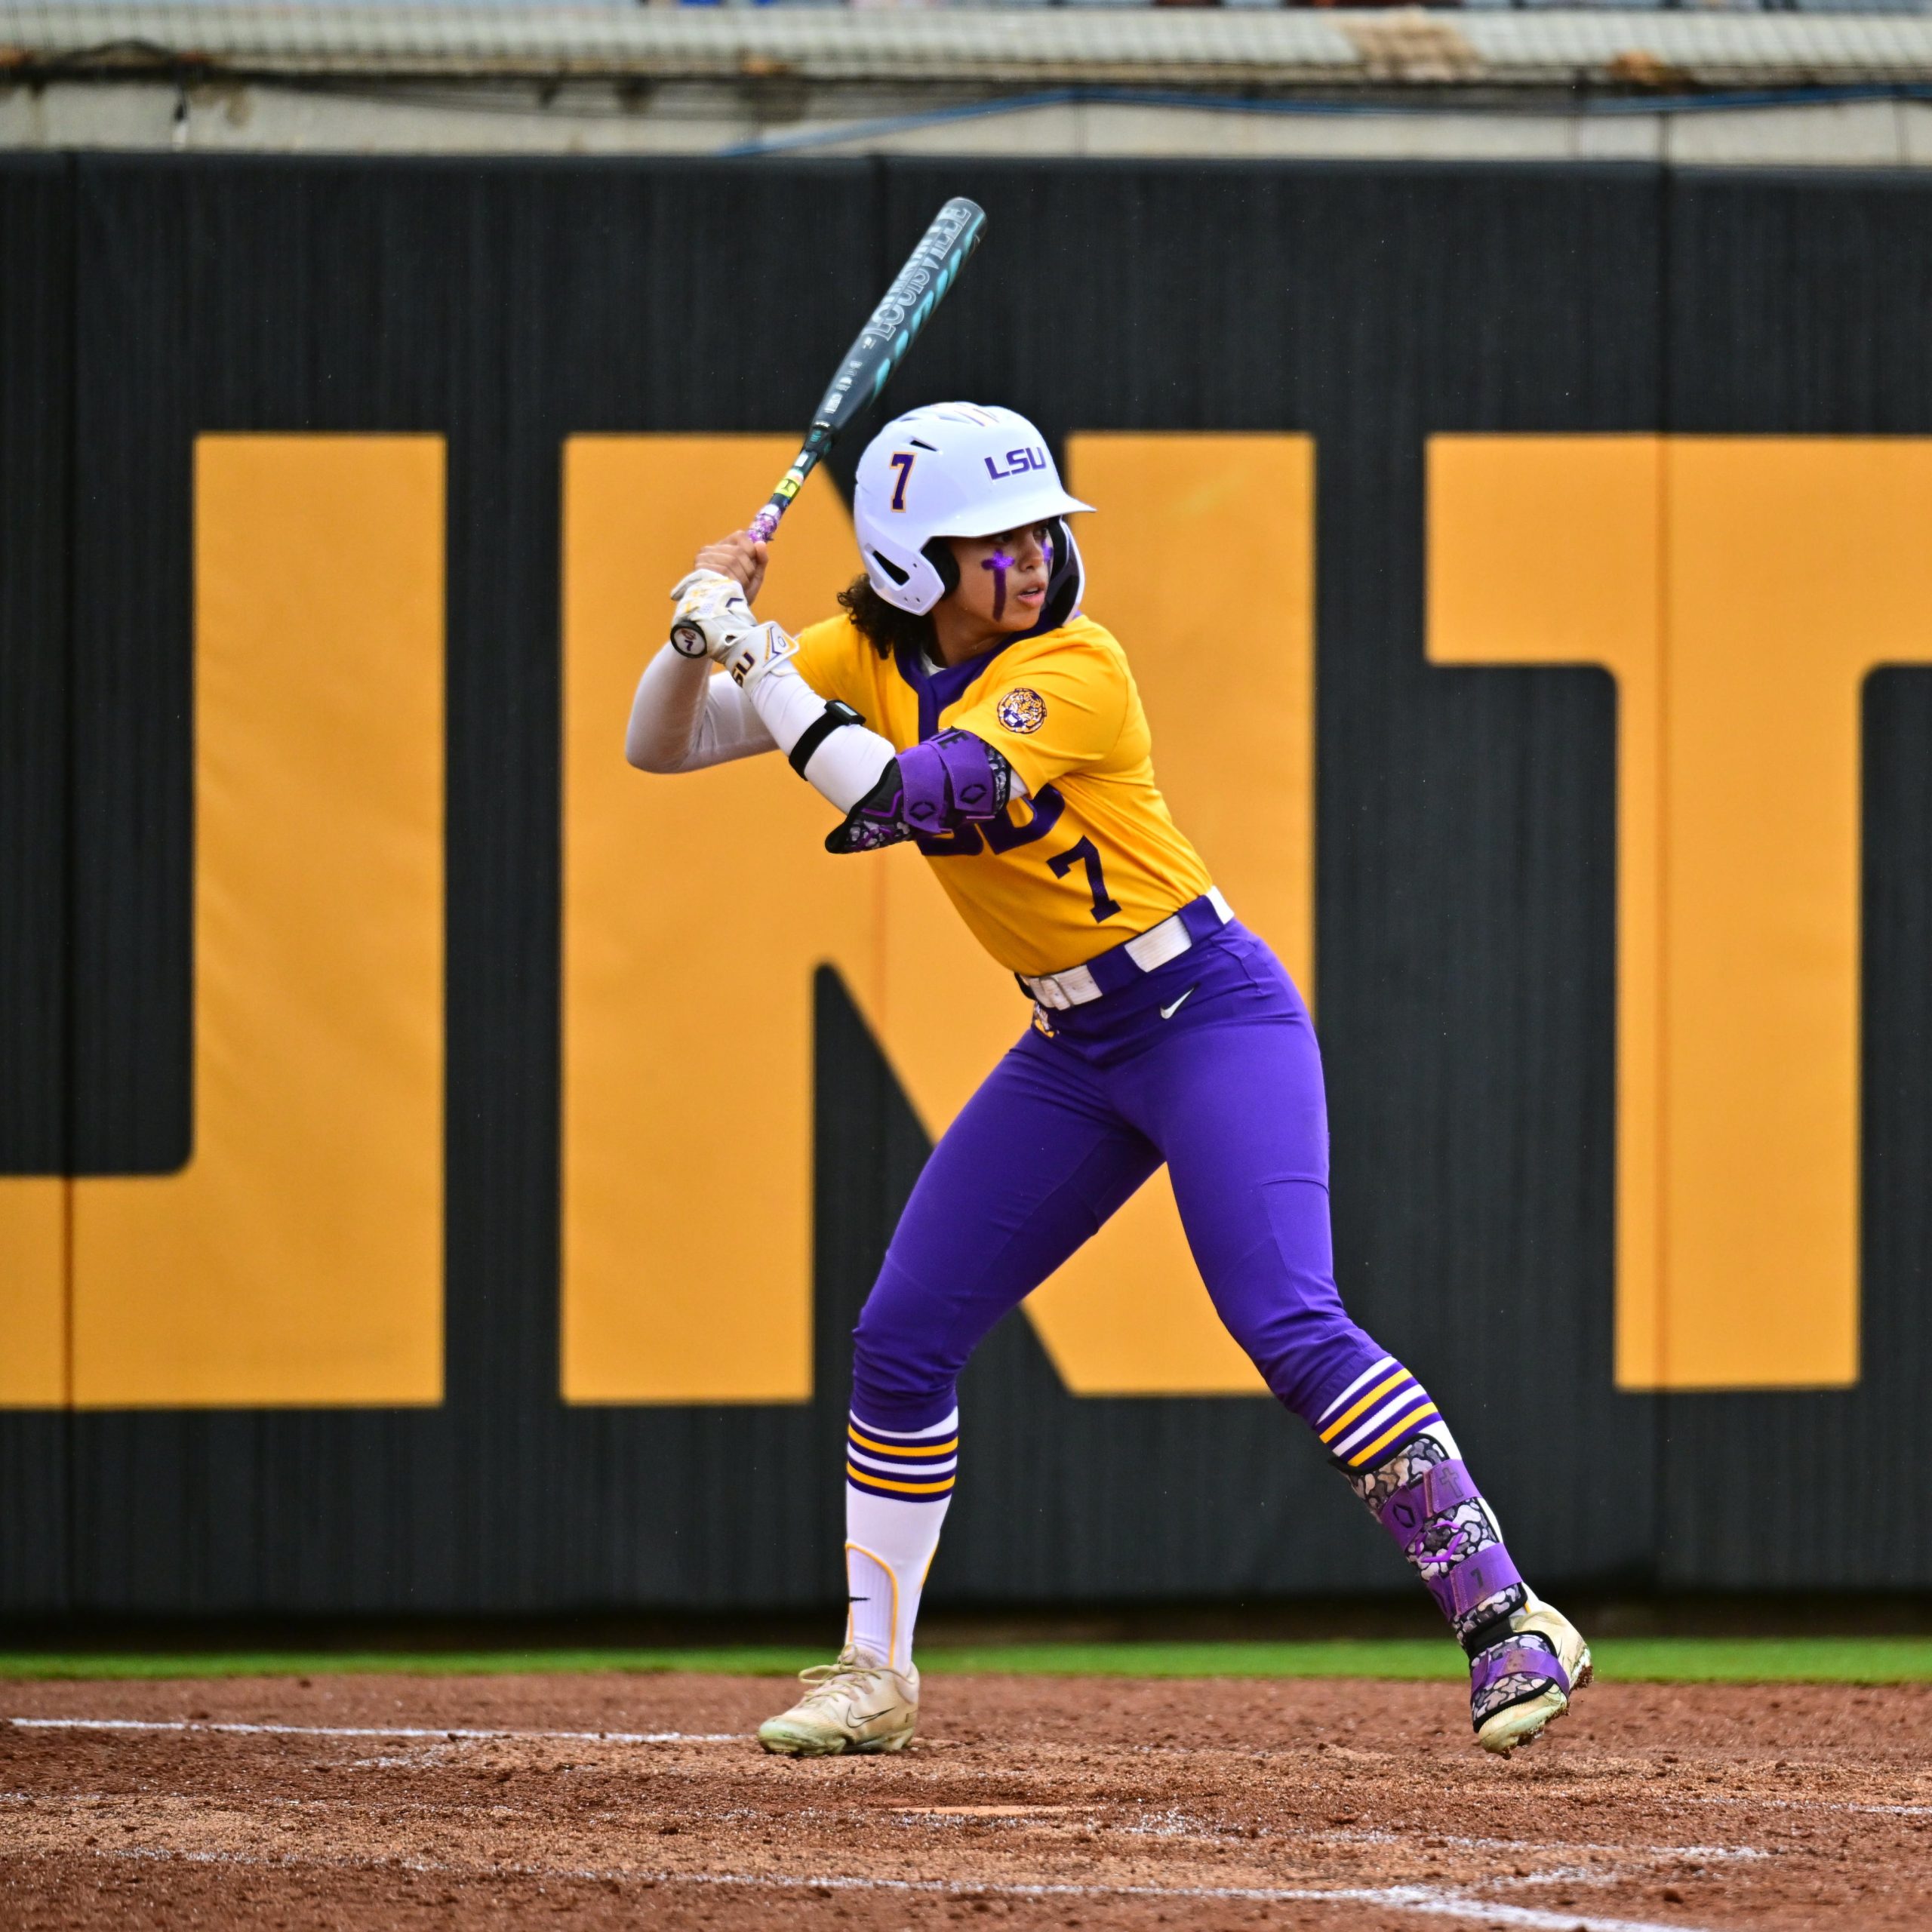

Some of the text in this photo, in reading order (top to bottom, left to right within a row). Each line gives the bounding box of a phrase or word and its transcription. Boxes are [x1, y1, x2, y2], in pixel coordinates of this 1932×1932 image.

[860, 207, 972, 341] LOUISVILLE
[889, 451, 918, 513] 7
[984, 447, 1047, 481] LSU
[1046, 835, 1122, 924] 7
[1470, 1567, 1484, 1589] 7
